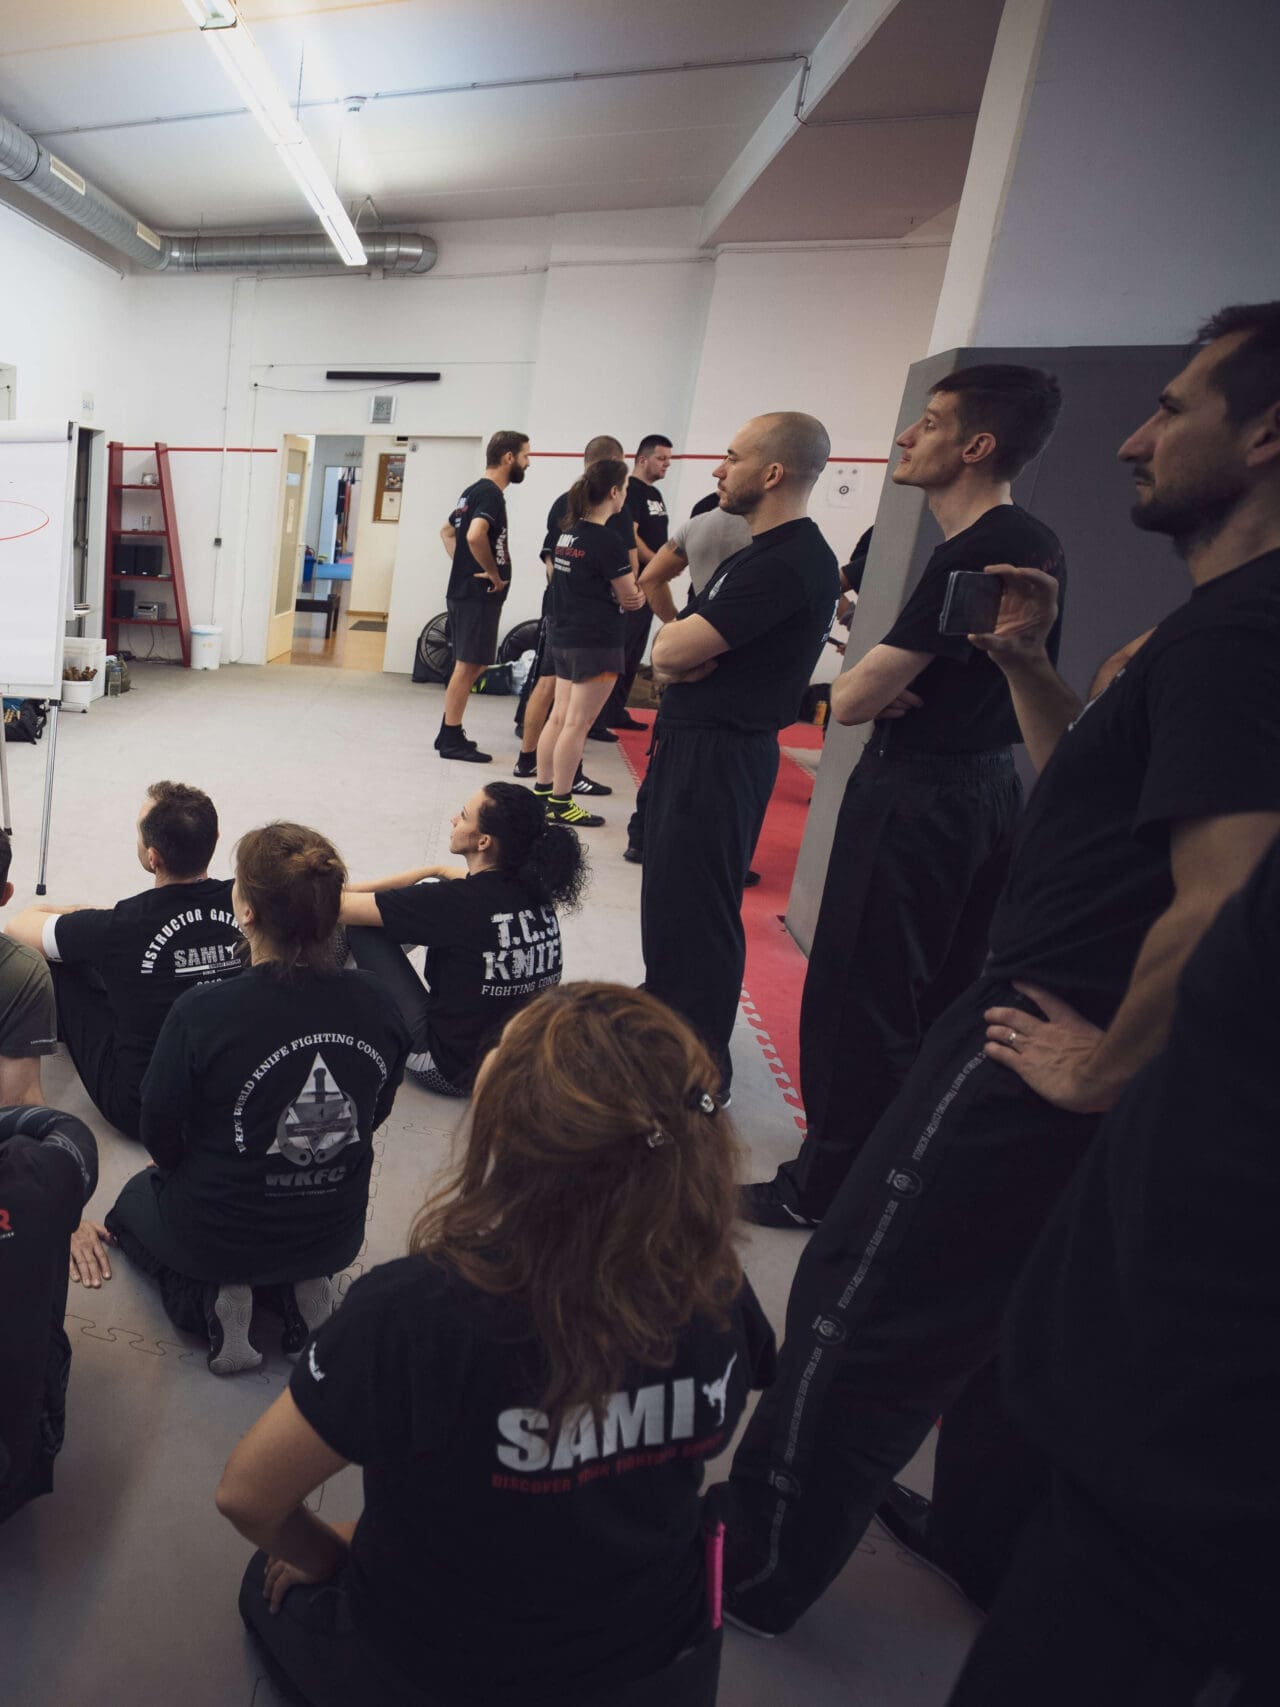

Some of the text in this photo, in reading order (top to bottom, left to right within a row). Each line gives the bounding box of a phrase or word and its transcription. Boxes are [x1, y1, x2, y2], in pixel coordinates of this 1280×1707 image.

[141, 909, 202, 973] INSTRUCTOR
[174, 945, 225, 968] SAMI
[482, 938, 563, 980] KNIF
[481, 981, 536, 997] FIGHTING
[233, 1081, 255, 1117] WORLD
[252, 1045, 290, 1081] KNIFE
[291, 1033, 355, 1051] FIGHTING
[266, 1166, 347, 1186] WKFC
[497, 1377, 695, 1472] SAMI
[491, 1471, 571, 1494] DISCOVER
